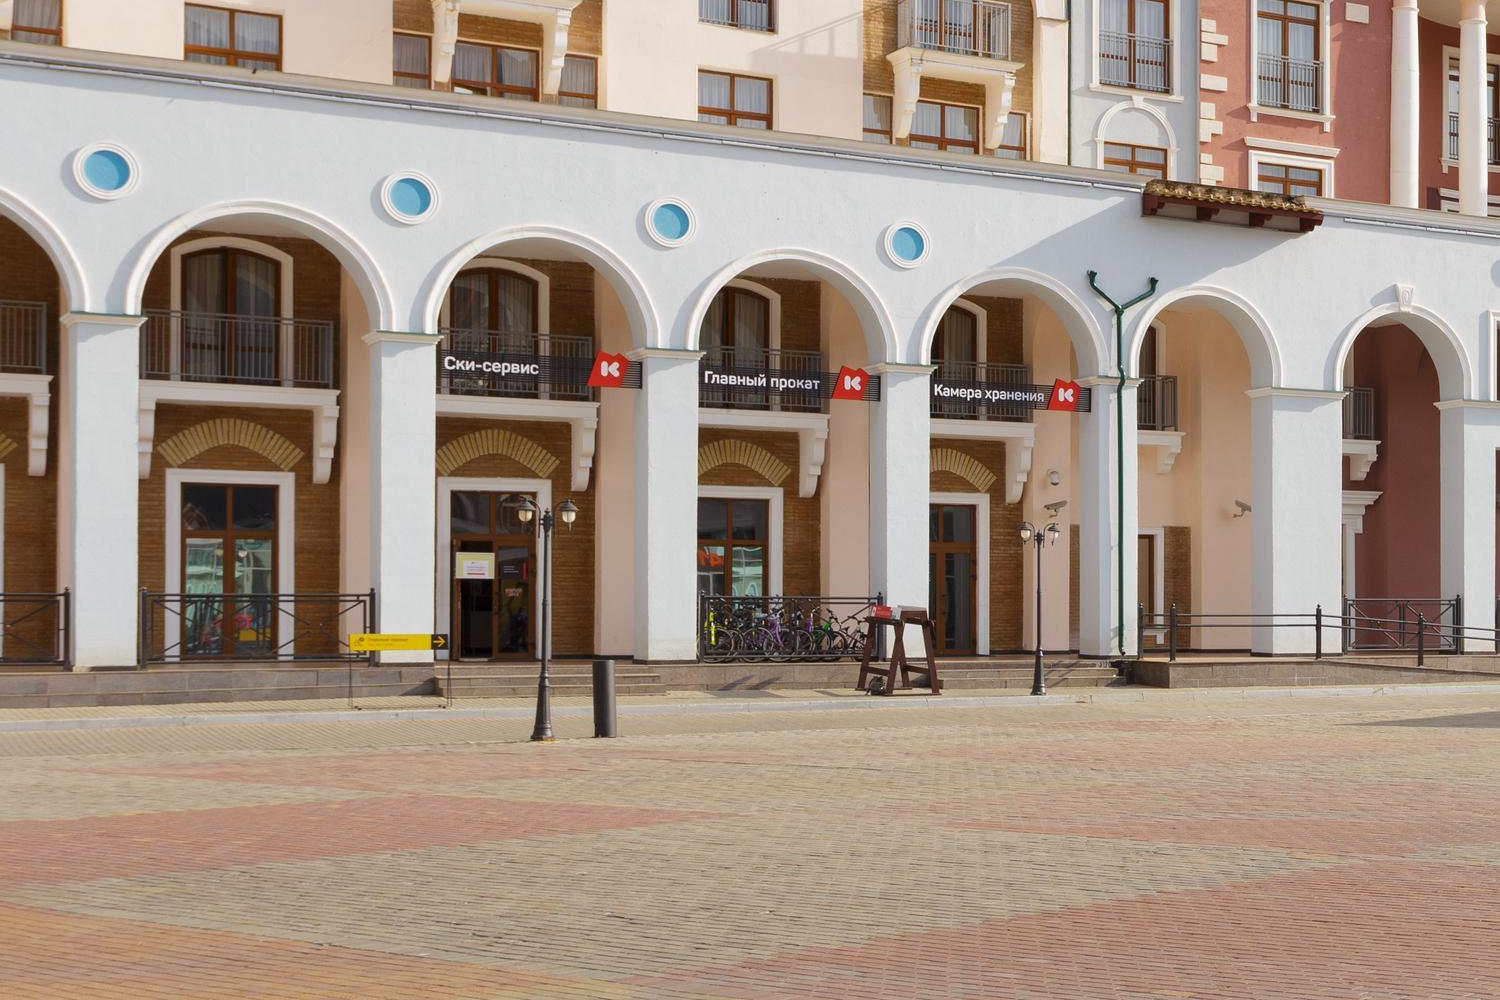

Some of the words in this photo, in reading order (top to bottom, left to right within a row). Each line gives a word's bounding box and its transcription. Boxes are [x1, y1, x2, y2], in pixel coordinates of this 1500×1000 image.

[444, 356, 540, 377] Ски-сервис
[704, 371, 767, 387] Главный
[770, 379, 821, 392] прокат
[934, 384, 982, 401] Камера
[985, 389, 1045, 403] хранения
